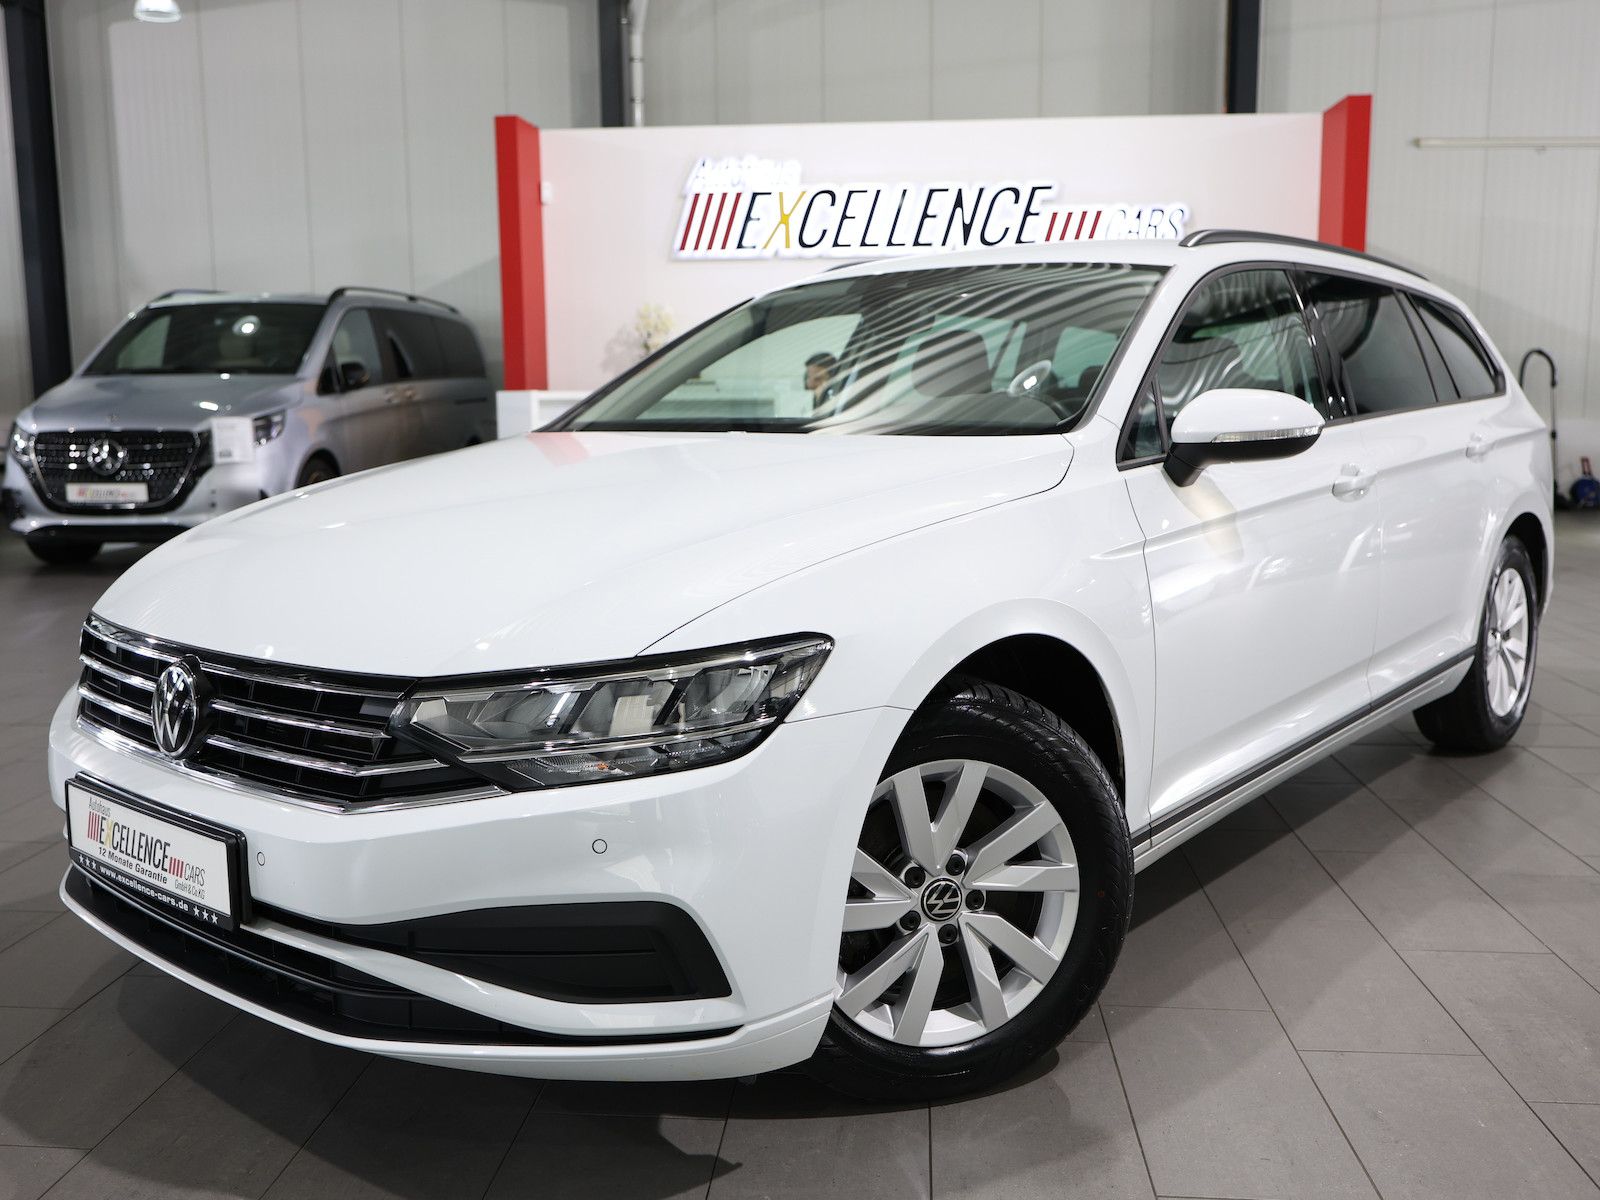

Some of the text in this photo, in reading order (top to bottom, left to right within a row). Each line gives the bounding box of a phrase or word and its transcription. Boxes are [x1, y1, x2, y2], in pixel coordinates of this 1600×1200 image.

[736, 186, 1185, 249] EXCELLENCE CARS
[88, 796, 112, 818] Autohaus
[98, 815, 206, 887] EXCELLENCE CARS
[98, 847, 168, 884] 12 Monate Garantie
[99, 865, 189, 911] www.excellence-cars.de
